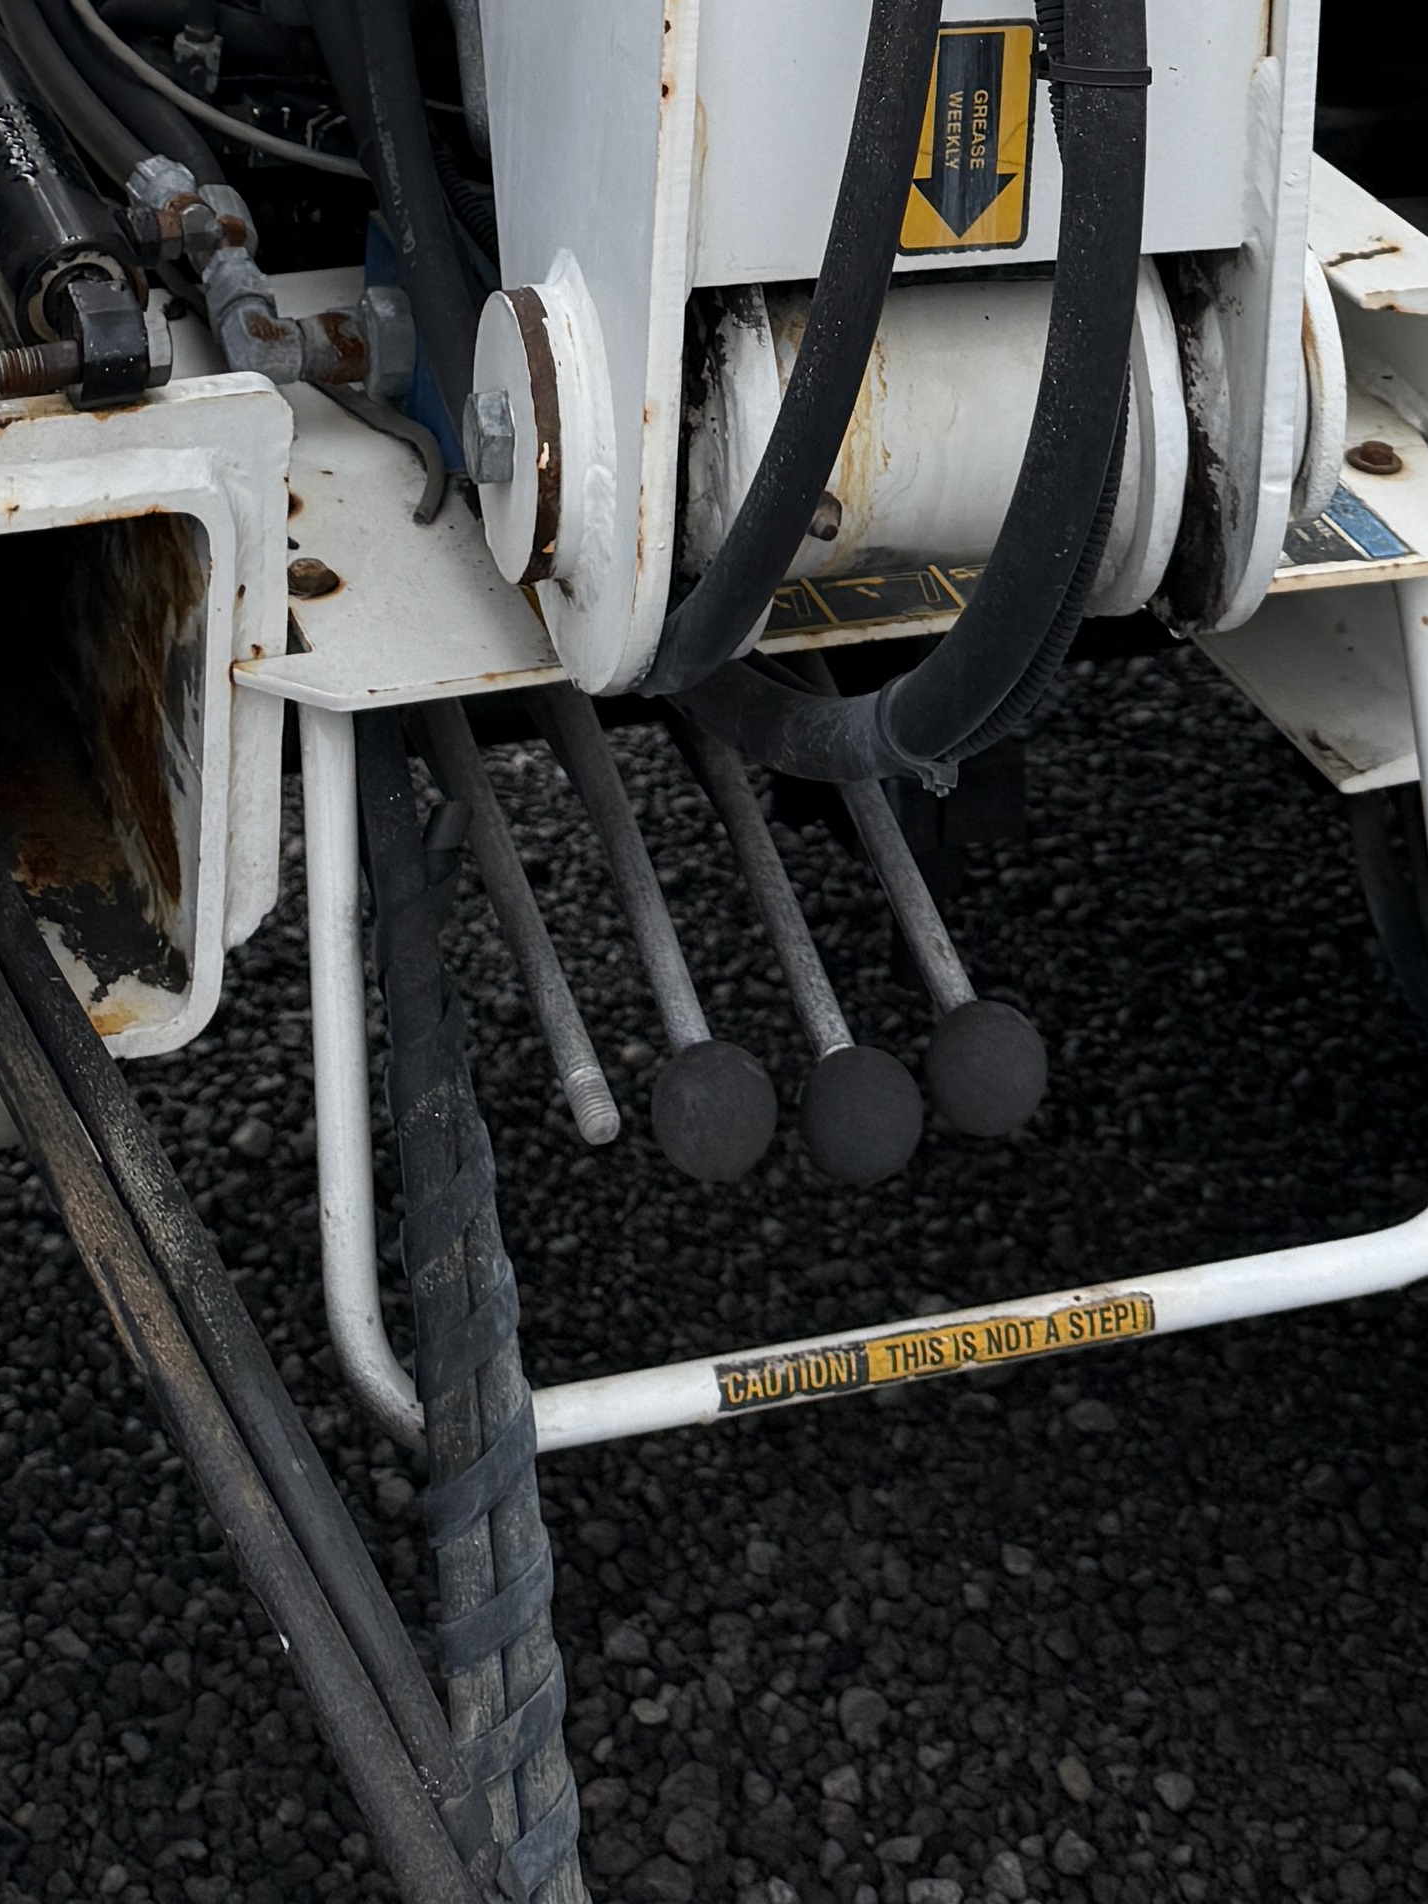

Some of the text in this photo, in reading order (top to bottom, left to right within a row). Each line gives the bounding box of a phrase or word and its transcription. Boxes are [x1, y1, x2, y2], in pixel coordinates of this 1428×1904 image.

[945, 90, 964, 170] WEEKLY
[970, 89, 989, 170] GREASE
[725, 1302, 1139, 1404] CAUTION! THIS IS NOT A STEP!
